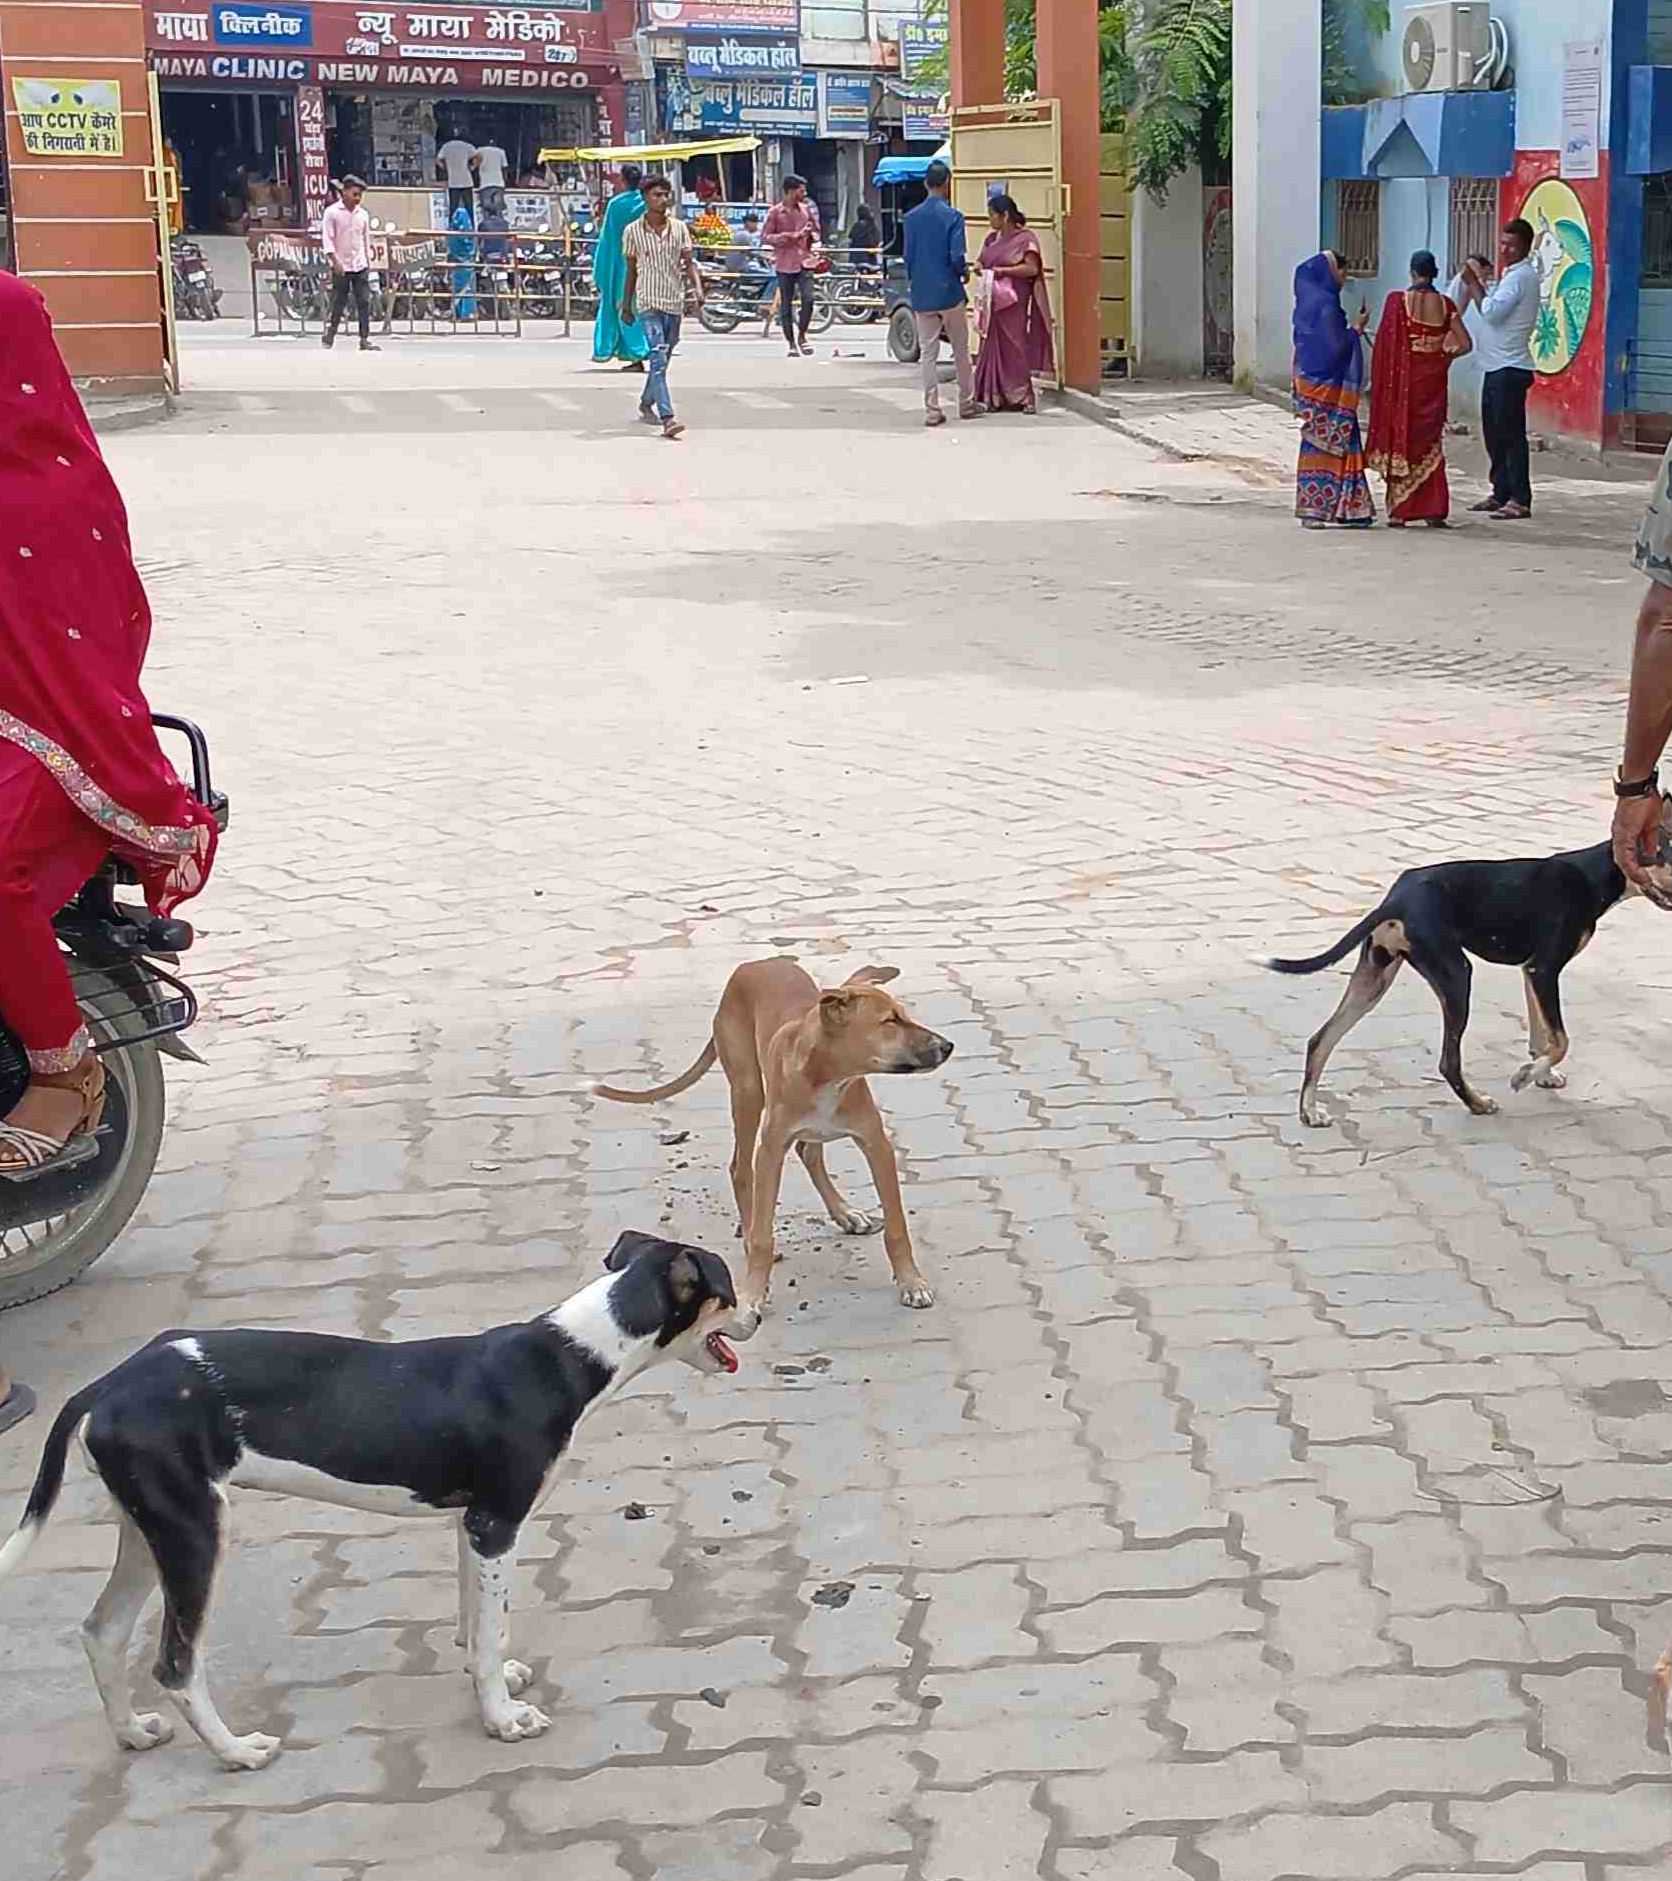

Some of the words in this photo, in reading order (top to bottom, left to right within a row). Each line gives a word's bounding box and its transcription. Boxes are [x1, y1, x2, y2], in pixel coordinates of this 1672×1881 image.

[154, 12, 209, 41] माया
[355, 11, 399, 45] न्यू
[406, 13, 474, 40] माया
[483, 10, 565, 43] मेडिको
[154, 57, 208, 77] MAYA
[212, 56, 305, 80] CLINIC
[318, 63, 378, 82] NEW
[387, 65, 459, 85] MAYA
[481, 68, 589, 88] MEDICO
[19, 113, 43, 128] आप
[46, 113, 87, 129] CCTV
[300, 100, 324, 122] 24
[304, 174, 328, 195] ICU
